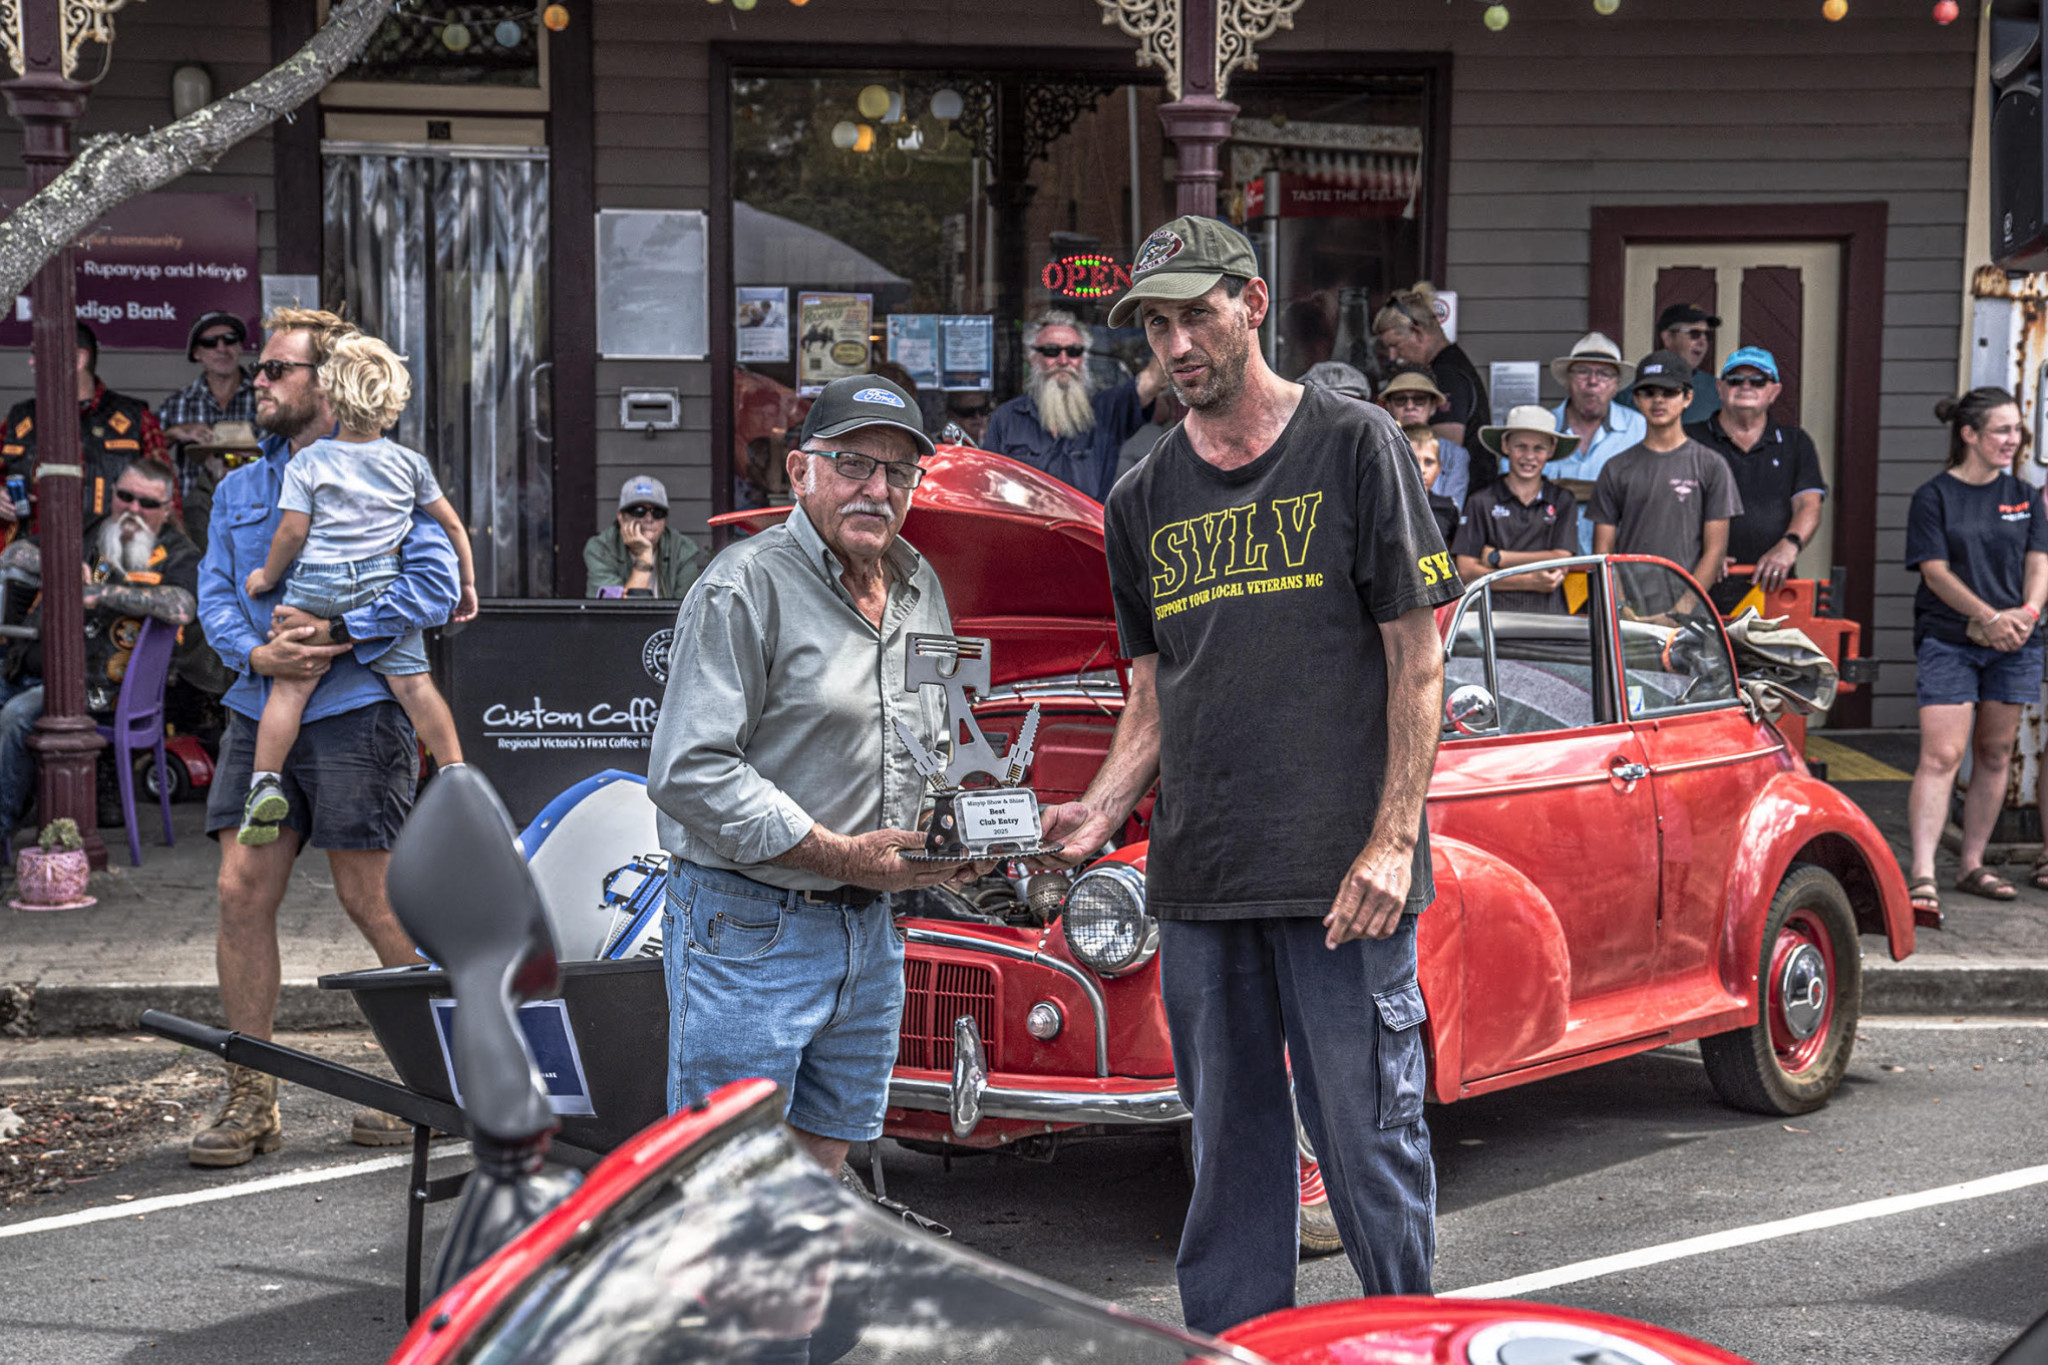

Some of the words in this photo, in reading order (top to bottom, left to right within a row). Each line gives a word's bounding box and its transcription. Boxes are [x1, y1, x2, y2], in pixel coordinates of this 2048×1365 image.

[1291, 190, 1331, 201] TASTE
[1334, 190, 1359, 201] THE
[1362, 188, 1413, 200] FEELIN
[110, 234, 184, 251] community
[84, 260, 162, 280] Rupanyup
[165, 261, 194, 277] and
[198, 263, 248, 282] Minyip
[1041, 262, 1133, 290] OPEN
[75, 300, 123, 323] ndigo
[127, 301, 177, 320] Bank
[863, 390, 897, 404] Ford
[1417, 551, 1453, 586] SY
[1155, 597, 1187, 620] SUPPORT
[1189, 589, 1210, 609] YOUR
[1211, 582, 1244, 600] LOCAL
[1247, 574, 1303, 595] VETERANS
[1305, 573, 1324, 588] MC
[483, 696, 584, 730] Custom
[588, 697, 661, 733] Coffe
[498, 737, 540, 751] Regional
[542, 737, 585, 750] Victoria's
[587, 737, 608, 750] First
[609, 737, 639, 750] Coffee
[979, 818, 997, 826] Club
[998, 818, 1019, 826] Entry
